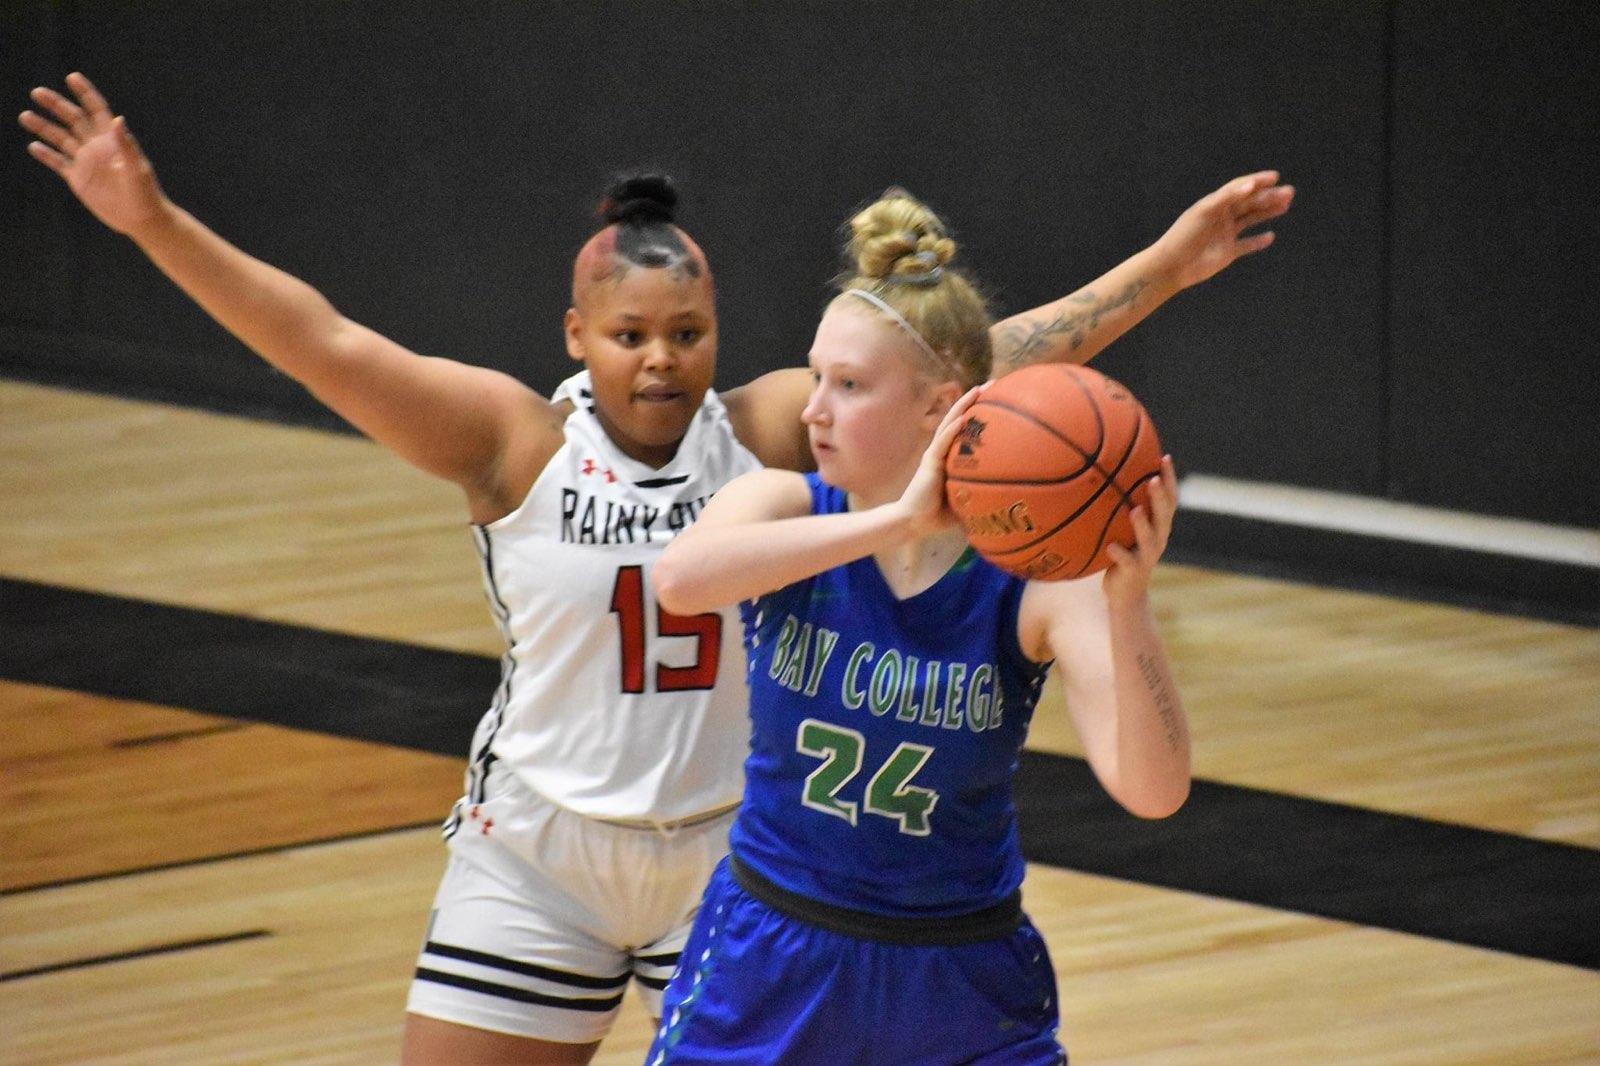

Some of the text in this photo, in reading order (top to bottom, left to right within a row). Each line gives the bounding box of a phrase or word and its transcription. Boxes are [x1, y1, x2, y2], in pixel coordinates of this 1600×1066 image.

[561, 487, 659, 544] RAINY
[609, 564, 723, 694] 15
[768, 613, 1004, 733] BAY COLLEGE
[796, 718, 940, 837] 24
